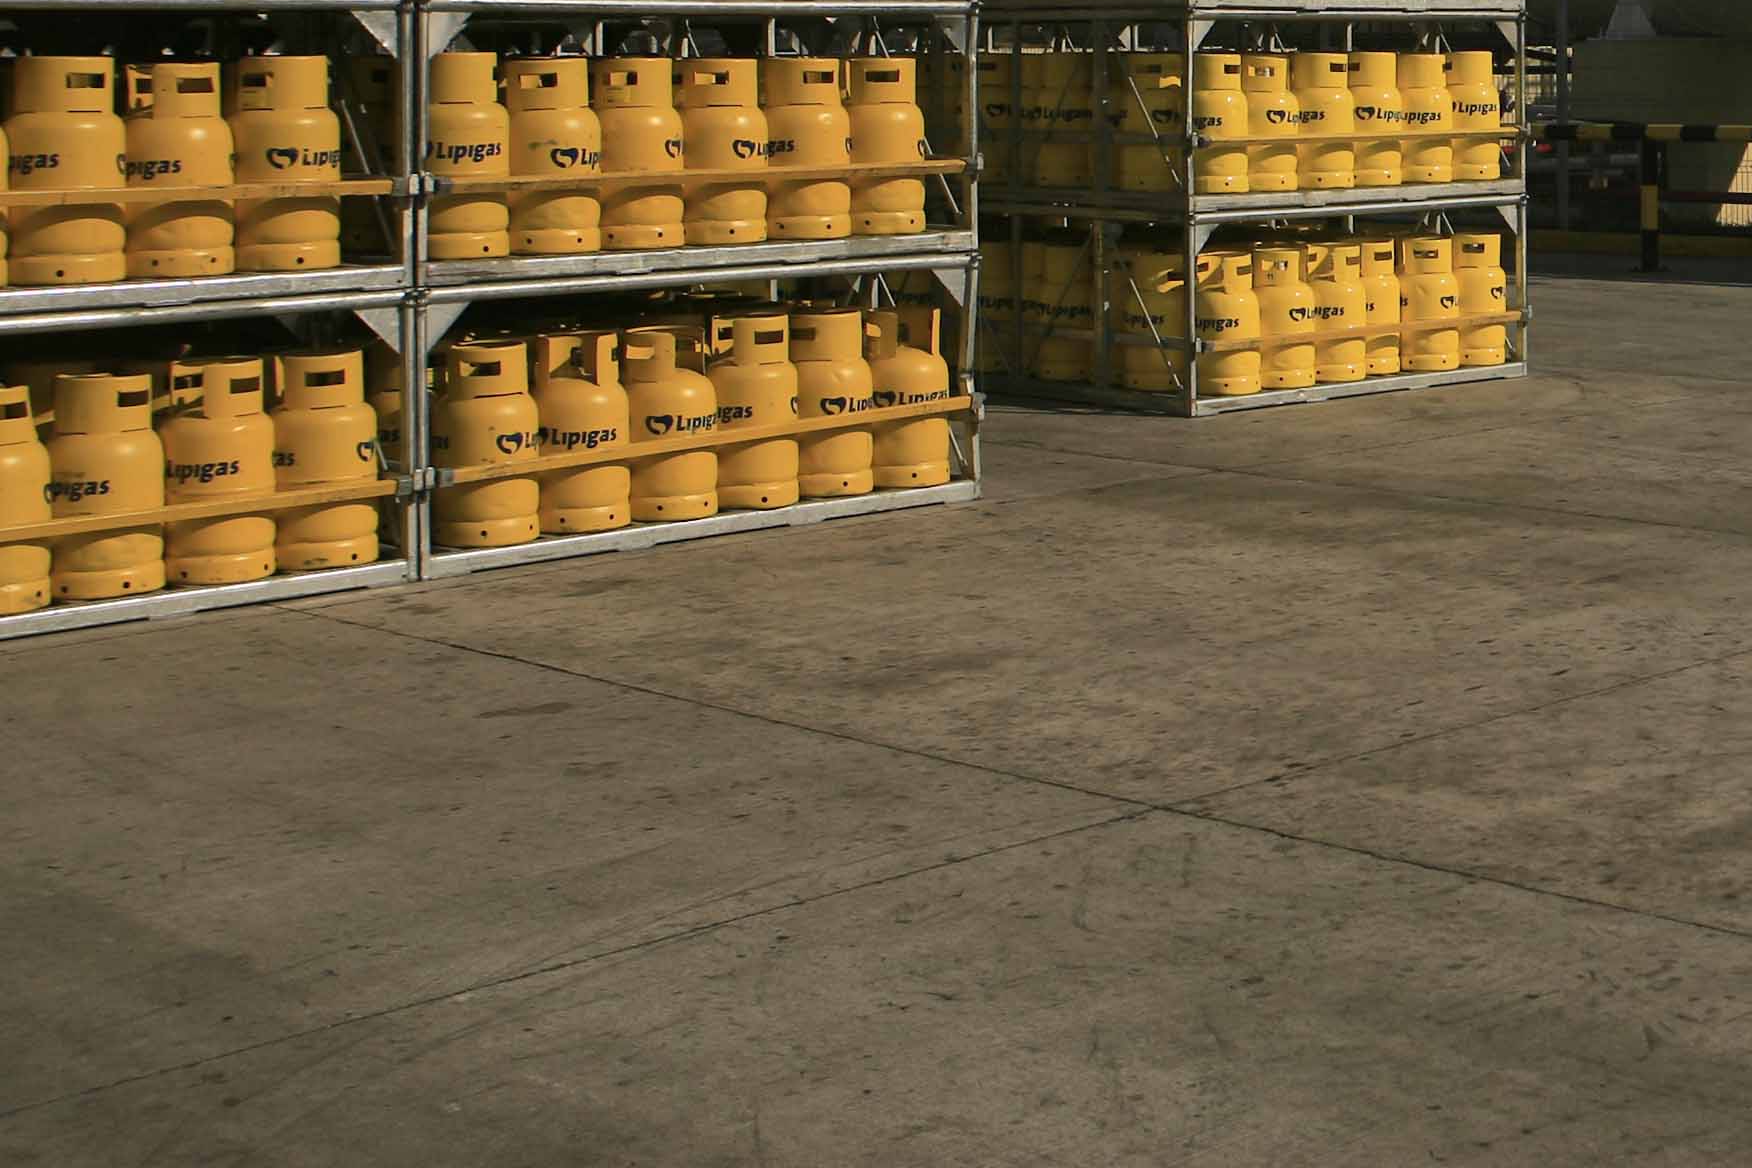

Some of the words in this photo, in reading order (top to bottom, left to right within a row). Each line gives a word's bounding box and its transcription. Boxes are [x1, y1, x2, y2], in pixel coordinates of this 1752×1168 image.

[1404, 111, 1440, 124] ipigas
[437, 142, 501, 164] Lipigas
[127, 160, 181, 180] pigas
[677, 414, 716, 432] Lipiga
[552, 427, 617, 449] Lipigas
